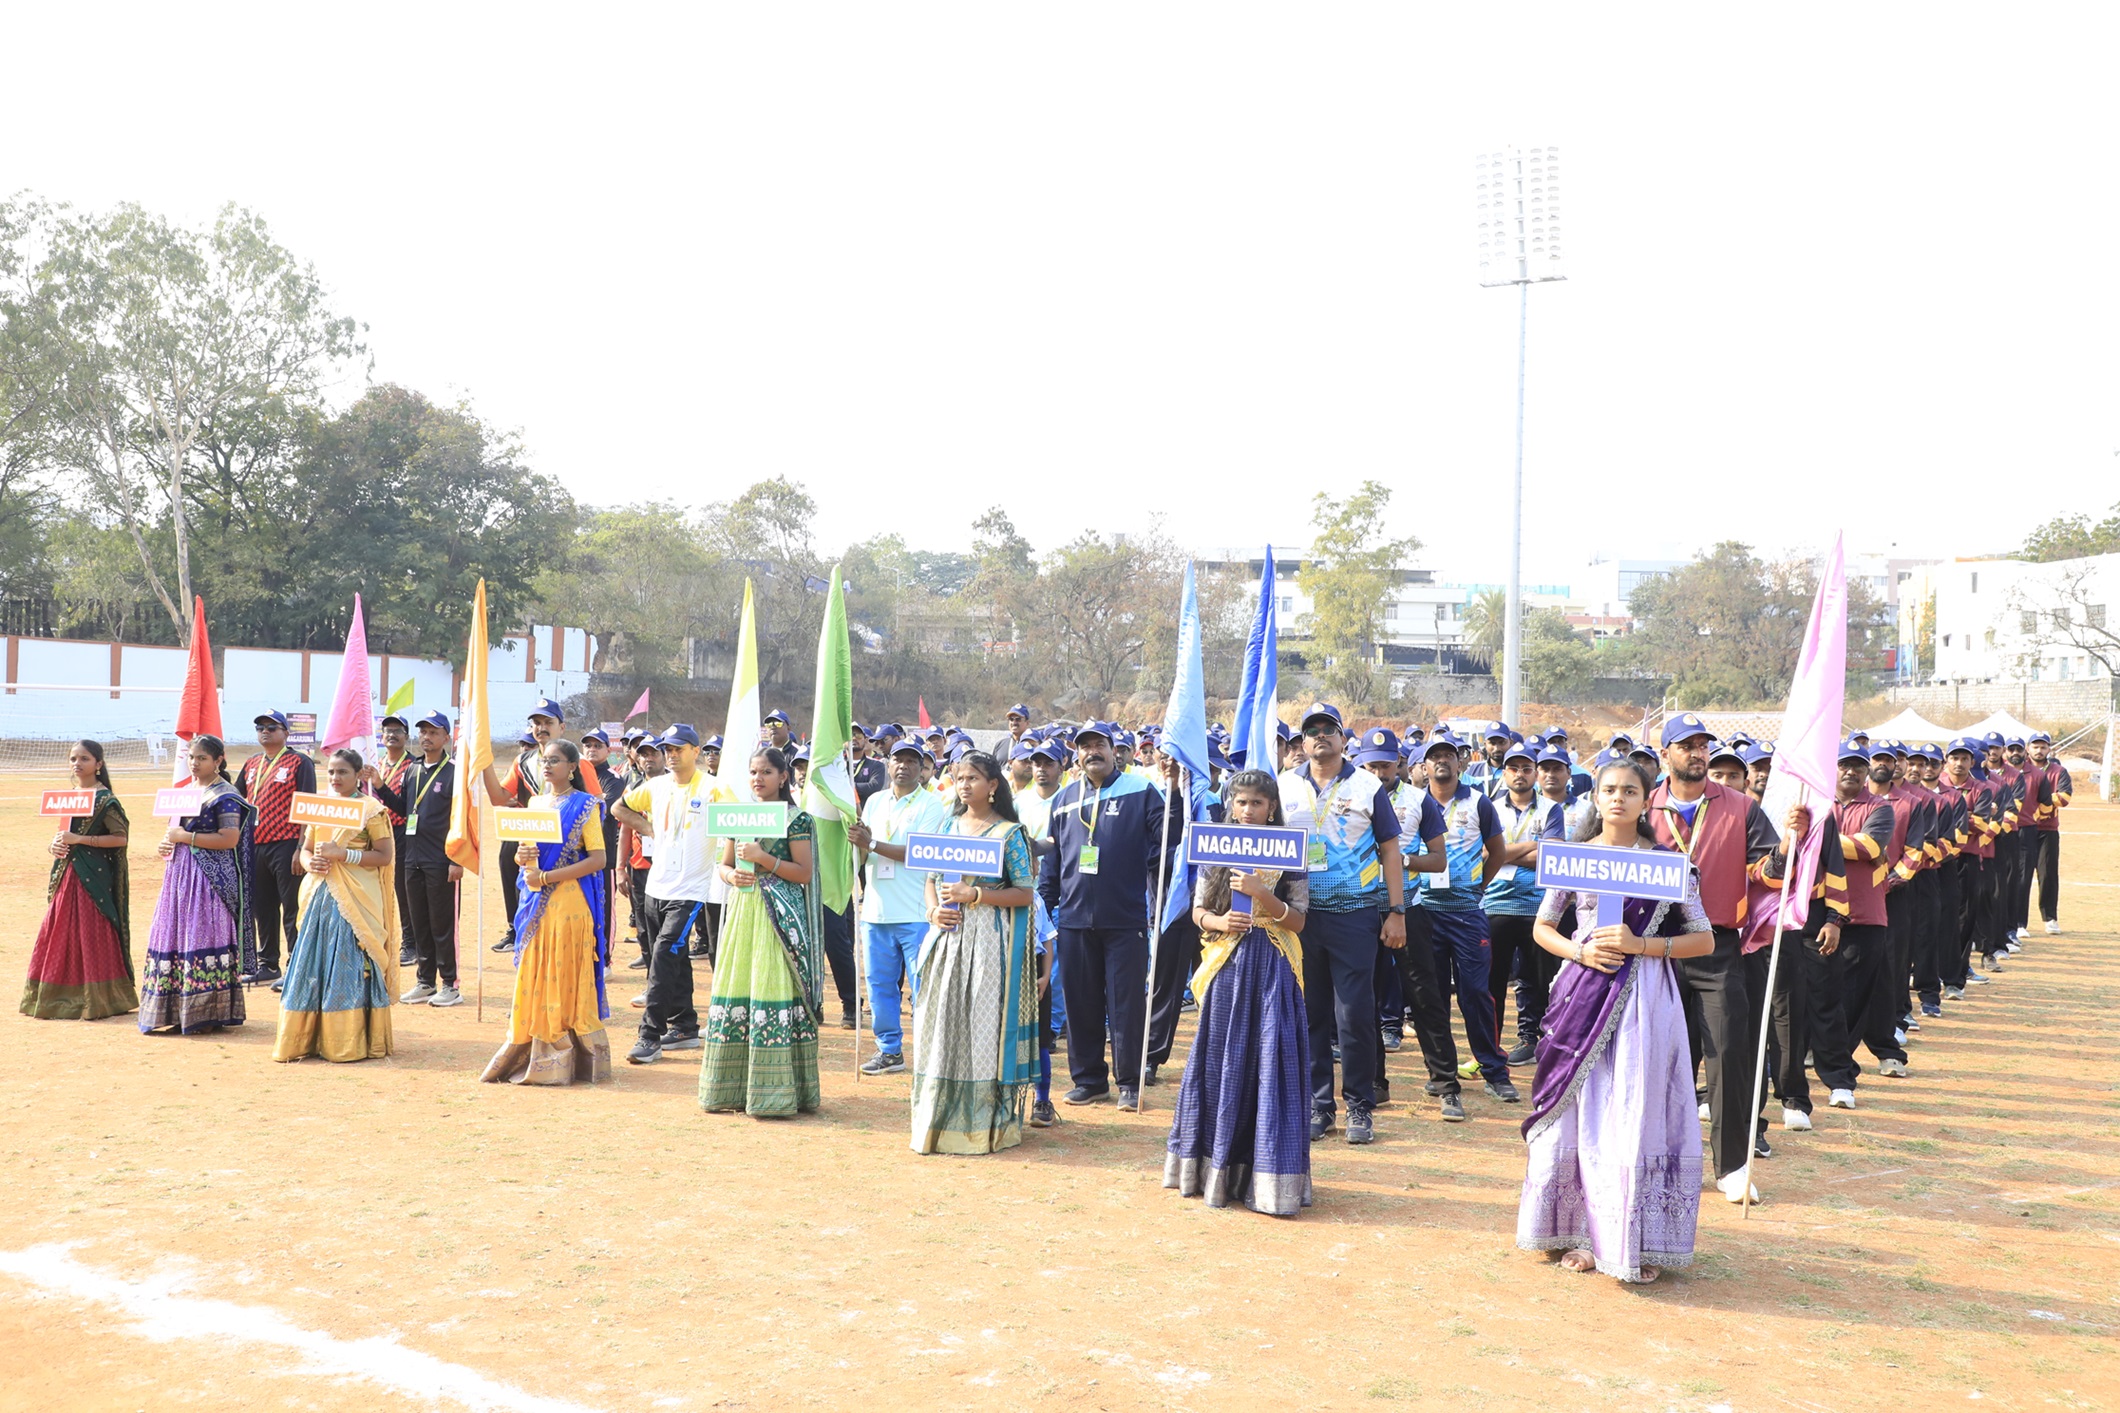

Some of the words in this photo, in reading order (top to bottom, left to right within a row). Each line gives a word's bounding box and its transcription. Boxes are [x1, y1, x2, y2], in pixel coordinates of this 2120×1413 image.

[46, 796, 89, 809] AJANTA
[158, 795, 198, 809] ELLORA
[296, 801, 360, 821] DWARAKA
[717, 812, 777, 827] KONARK
[501, 818, 556, 833] PUSHKAR
[911, 844, 997, 865] GOLCONDA
[1197, 834, 1298, 859] NAGARJUNA
[1544, 854, 1682, 888] RAMESWARAM
